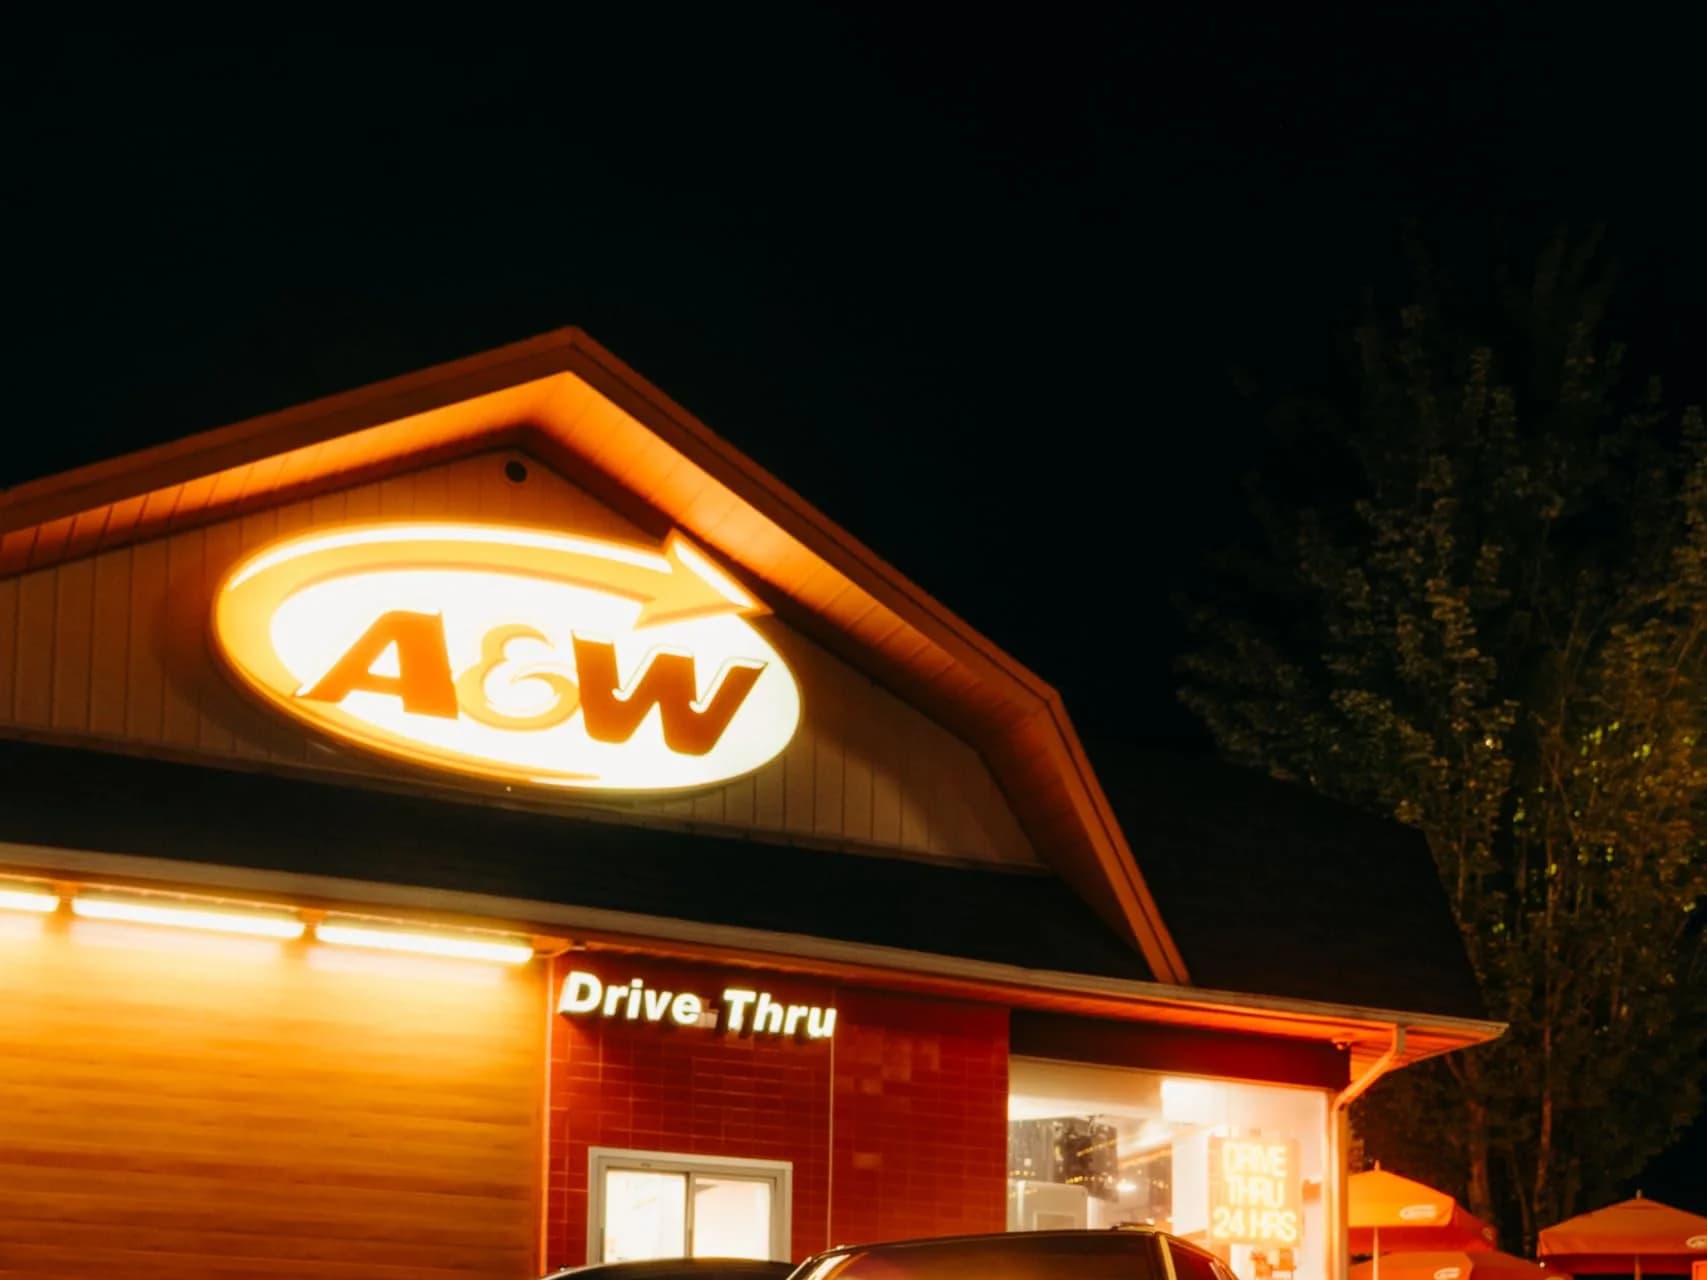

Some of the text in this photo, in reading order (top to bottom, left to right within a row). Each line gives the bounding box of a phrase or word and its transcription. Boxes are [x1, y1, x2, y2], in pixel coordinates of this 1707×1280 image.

[293, 609, 768, 757] A&W
[557, 970, 838, 1038] Drive Thru
[1213, 1206, 1298, 1242] 24 HRS
